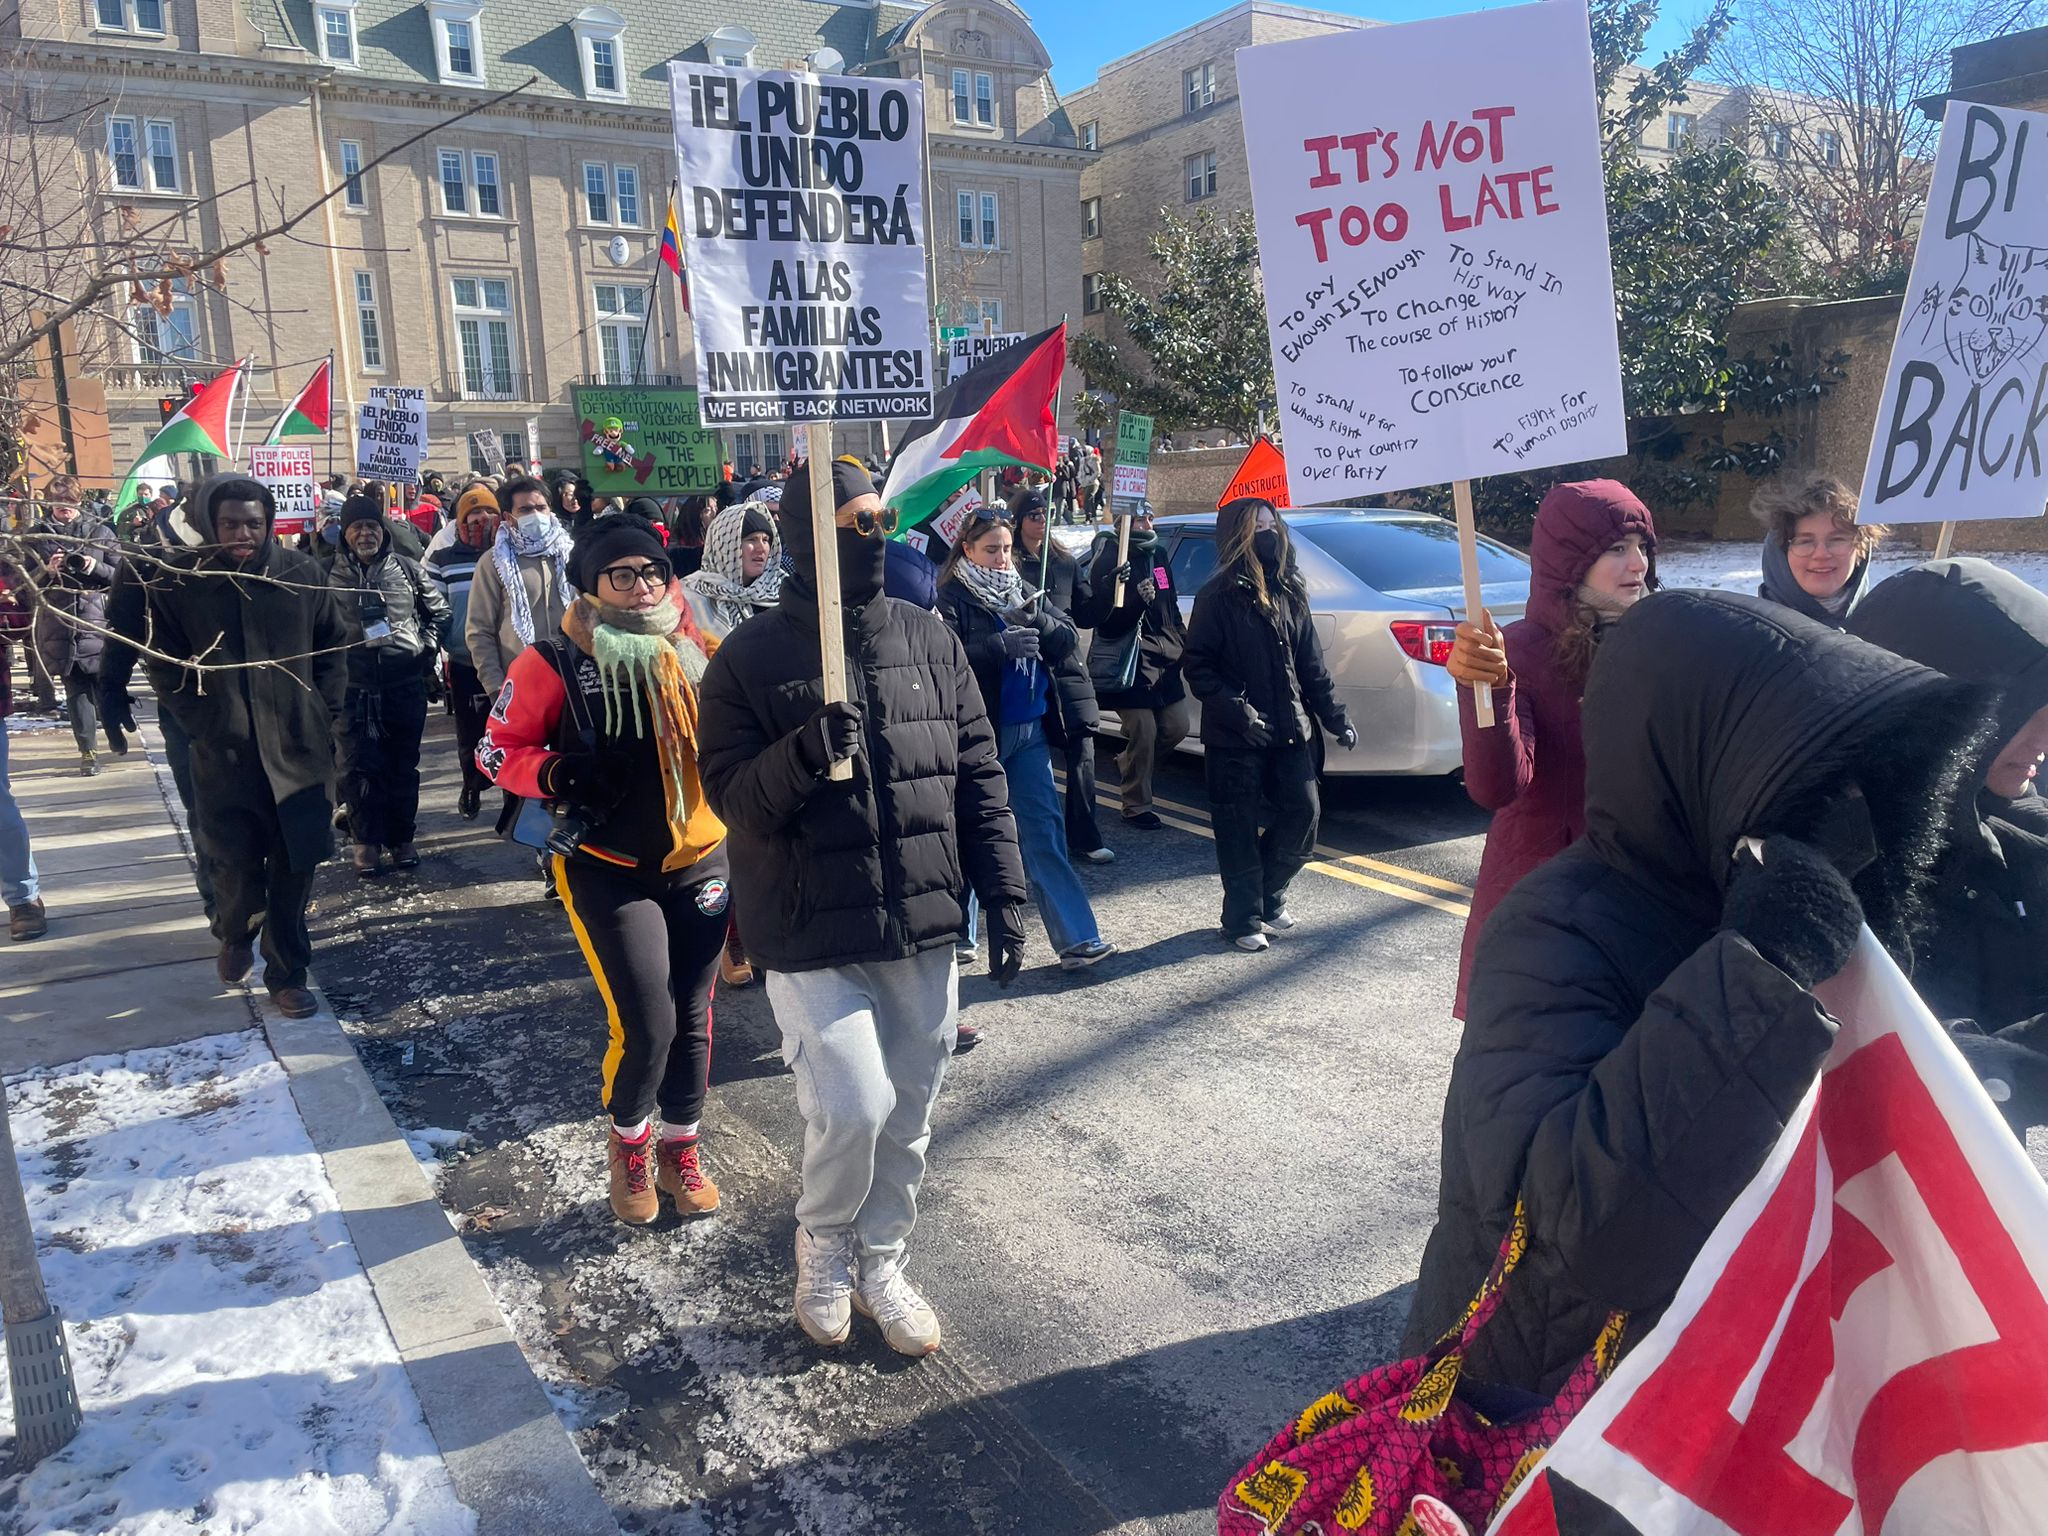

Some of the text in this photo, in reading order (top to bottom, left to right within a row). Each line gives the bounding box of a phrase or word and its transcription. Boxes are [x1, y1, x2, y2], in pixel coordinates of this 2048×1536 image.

[688, 75, 910, 142] ¡EL PUEBLO
[1303, 106, 1516, 189] IT'S NOT
[740, 135, 863, 192] UNIDO
[1945, 105, 2048, 240] BI
[693, 184, 916, 246] DEFENDERÁ
[1295, 165, 1561, 263] TOO LATE
[768, 259, 851, 302] A LAS
[1539, 271, 1564, 295] In
[1332, 290, 1361, 318] IS
[1396, 293, 1480, 320] Change
[741, 306, 883, 347] FAMILIAS
[1345, 335, 1377, 353] The
[1381, 328, 1433, 348] course
[706, 350, 924, 392] INMIGRANTES!
[1420, 361, 1473, 383] follow
[1480, 348, 1517, 372] your
[370, 387, 388, 399] THE
[580, 391, 614, 402] LUIGI
[1410, 373, 1525, 414] Conscience
[386, 399, 409, 410] ILL
[708, 397, 928, 418] WE FIGHT BACK NETWORK
[374, 419, 407, 433] UNIDO
[380, 408, 420, 424] PUEBLO
[1378, 417, 1396, 432] for
[361, 428, 419, 447] DEFENDERÁ
[643, 430, 714, 447] HANDS OFF
[1138, 428, 1146, 442] TO
[1875, 360, 2048, 505] BACK
[255, 450, 310, 460] STOP POLICE
[377, 445, 401, 456] A LAS
[591, 433, 633, 464] FREE ME!
[665, 446, 695, 463] THE
[1116, 448, 1150, 465] PALESTINE
[255, 461, 311, 477] CRIMES
[358, 462, 417, 478] INMIGRANTES!
[369, 454, 407, 467] FAMILIAS
[657, 465, 719, 489] PEOPLE!
[1345, 463, 1388, 481] Party
[268, 484, 303, 499] FREE
[292, 500, 313, 512] ALL
